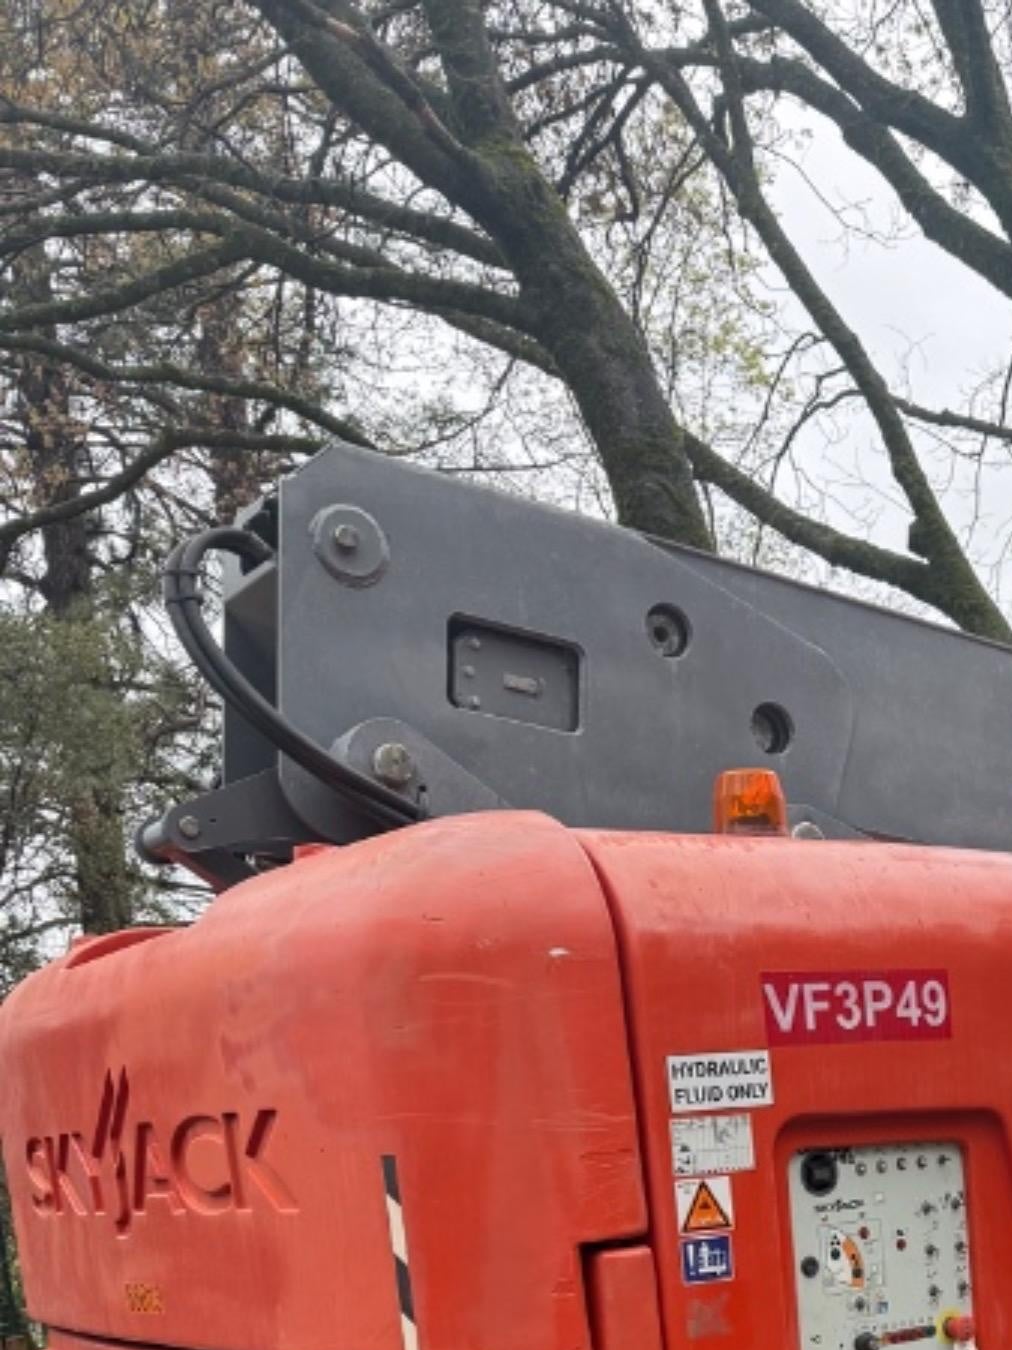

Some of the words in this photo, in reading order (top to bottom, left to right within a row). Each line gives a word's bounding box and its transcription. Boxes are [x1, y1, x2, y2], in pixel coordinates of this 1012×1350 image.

[763, 980, 946, 1032] VF3P49
[671, 1058, 766, 1081] HYDRAULIC
[674, 1086, 723, 1106] FLUID
[727, 1083, 768, 1102] ONLY
[26, 1065, 299, 1239] SKYJACK
